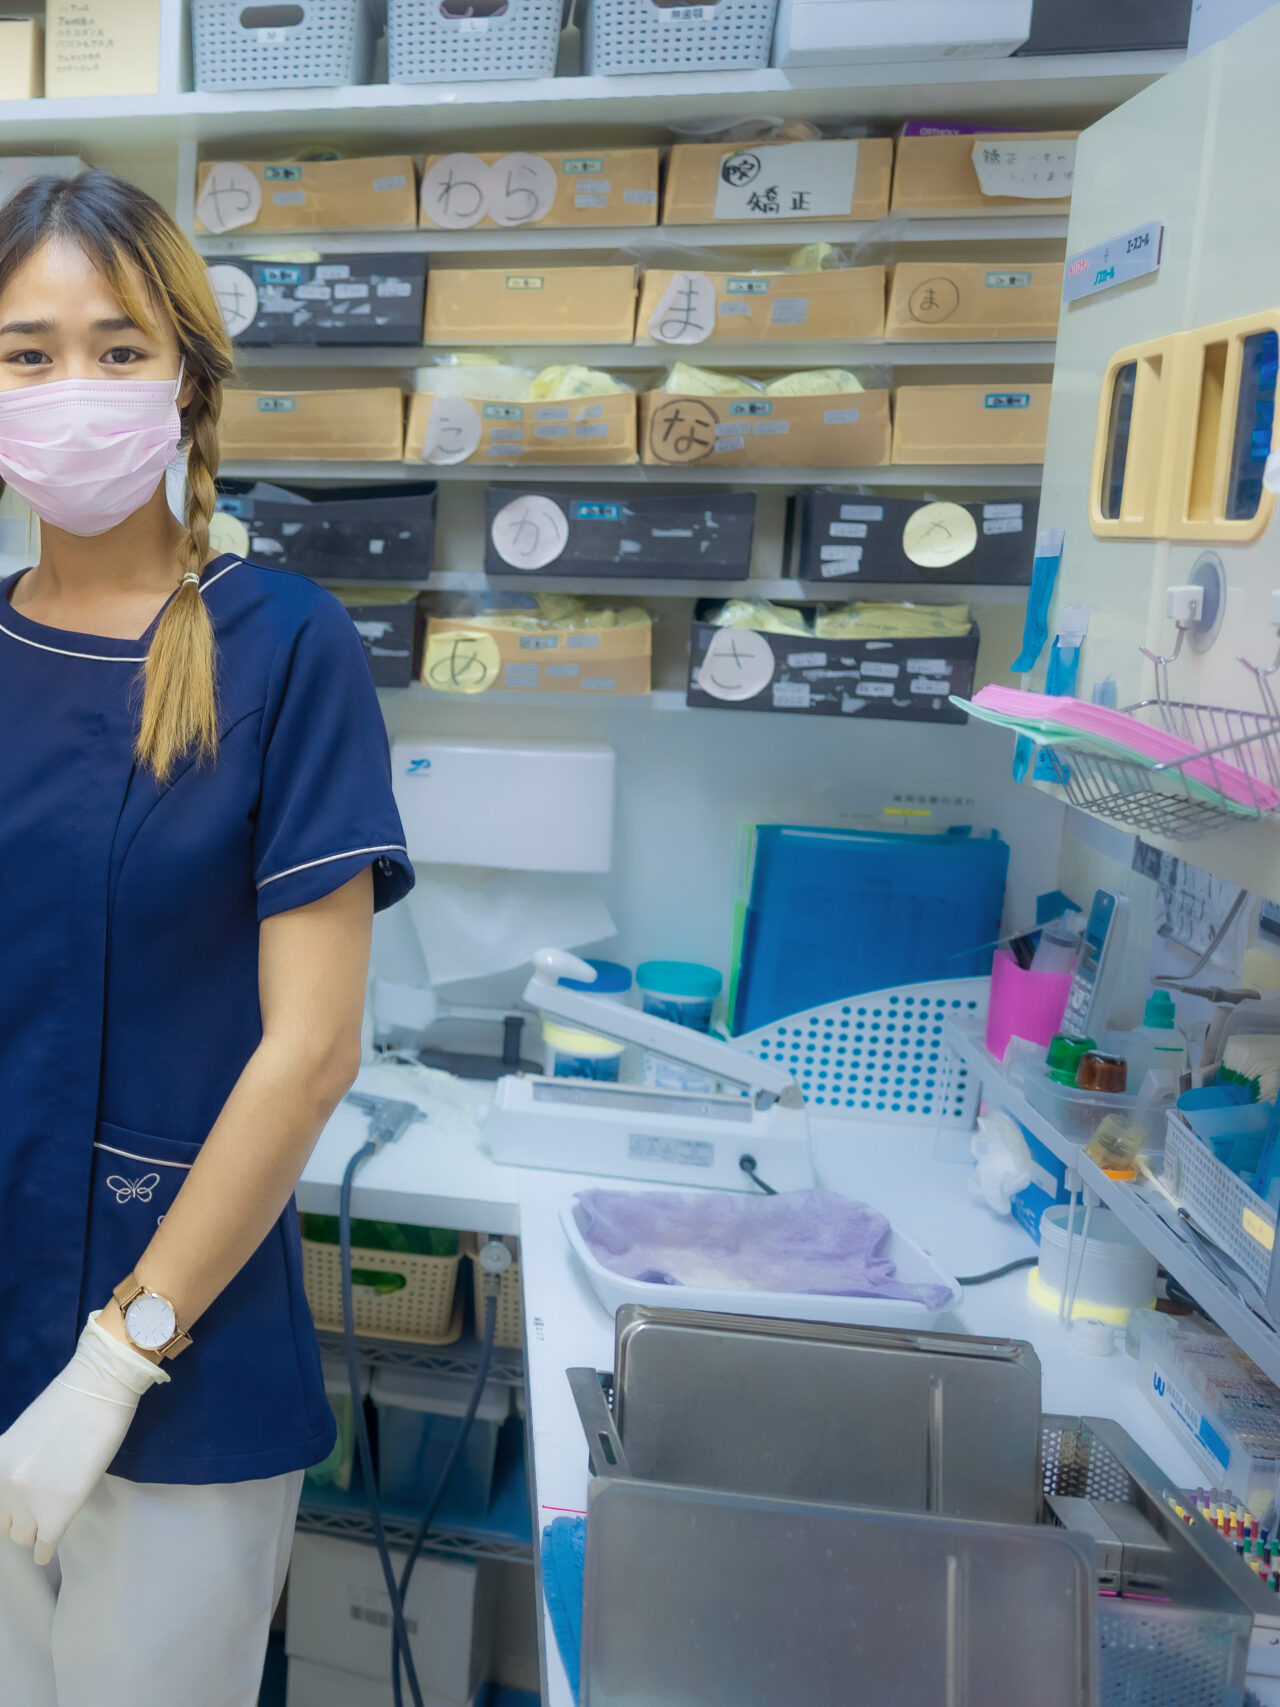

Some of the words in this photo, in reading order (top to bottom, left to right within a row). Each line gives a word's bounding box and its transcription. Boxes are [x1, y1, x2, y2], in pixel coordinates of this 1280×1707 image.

[207, 175, 252, 228] や
[746, 185, 813, 214] 矯正
[659, 276, 705, 339] ま
[662, 408, 710, 455] な
[508, 510, 561, 557] か
[429, 638, 488, 686] あ
